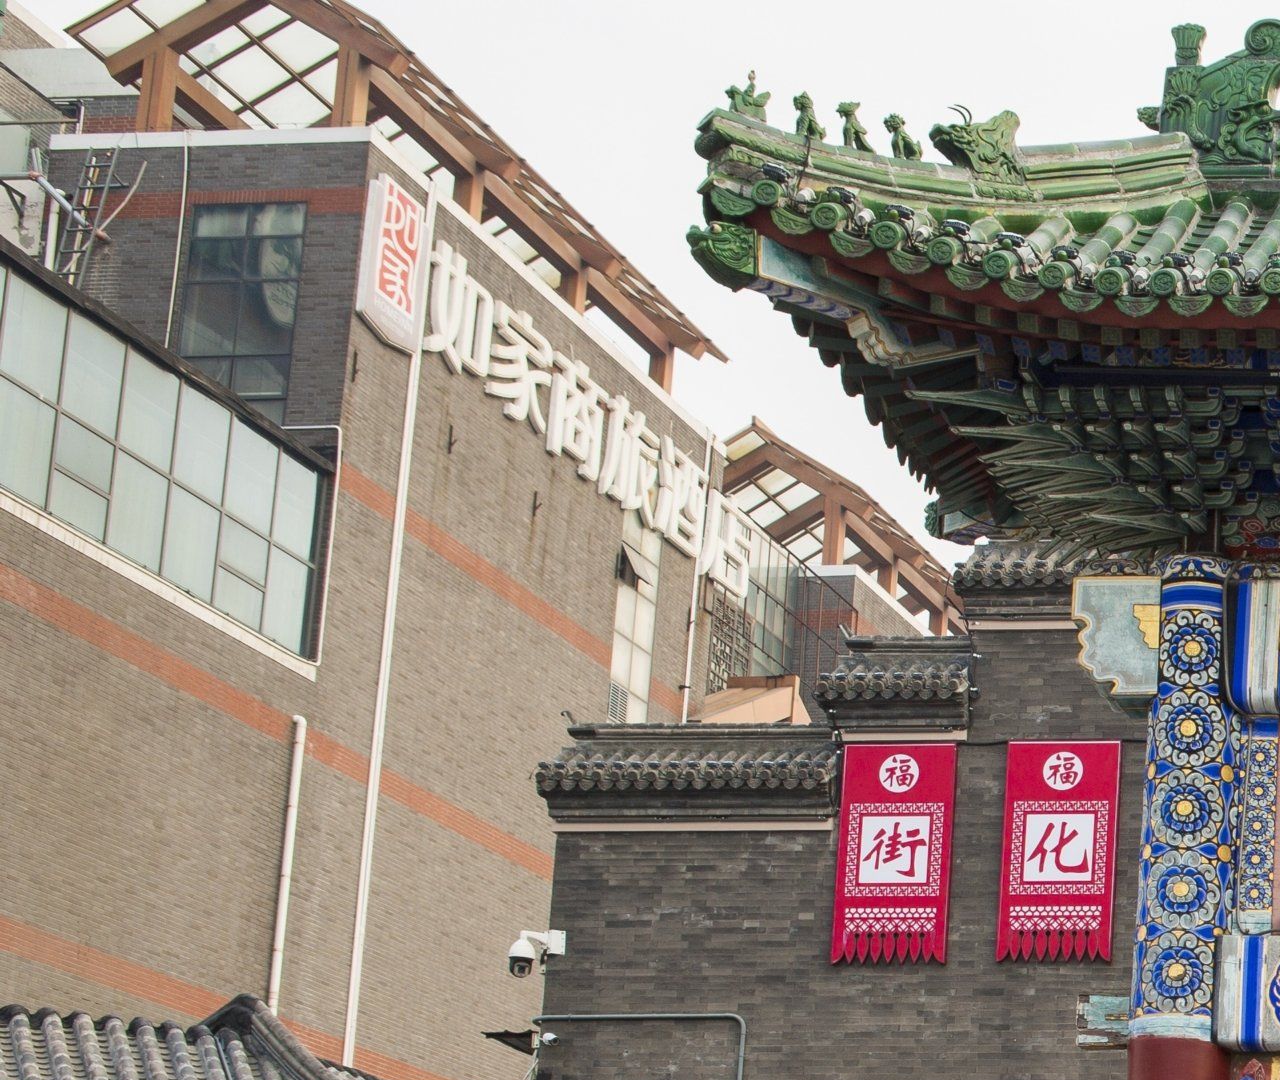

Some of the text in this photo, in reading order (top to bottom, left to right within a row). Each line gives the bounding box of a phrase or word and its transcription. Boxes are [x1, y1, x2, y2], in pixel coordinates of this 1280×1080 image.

[421, 239, 751, 600] 如家商旅酒店
[886, 755, 916, 792] 福
[1048, 754, 1080, 788] 福
[862, 822, 926, 878] 街
[1028, 821, 1091, 875] 化
